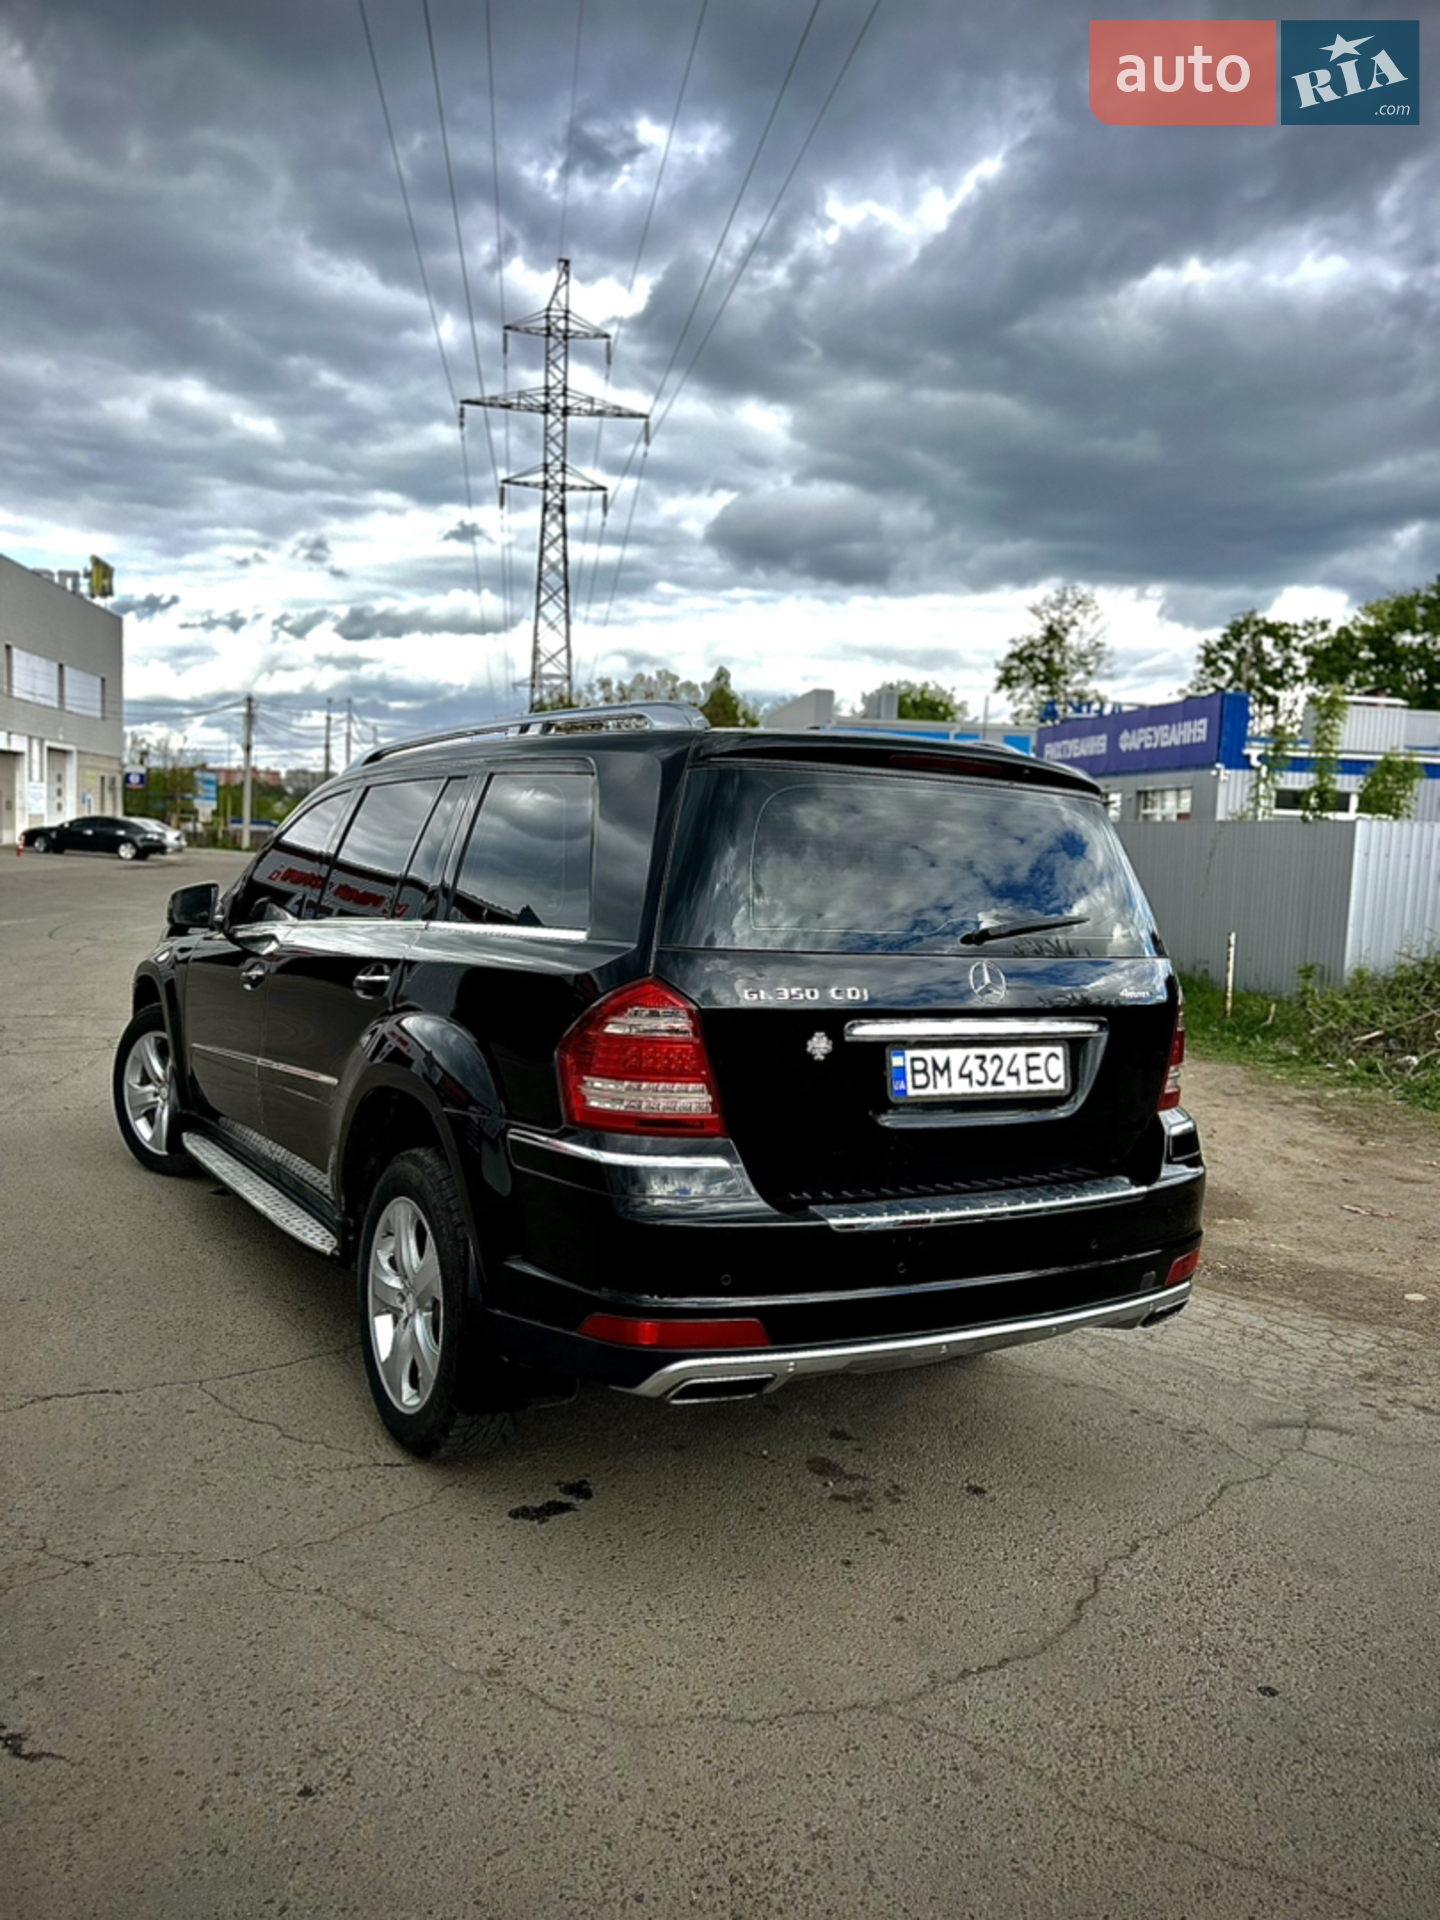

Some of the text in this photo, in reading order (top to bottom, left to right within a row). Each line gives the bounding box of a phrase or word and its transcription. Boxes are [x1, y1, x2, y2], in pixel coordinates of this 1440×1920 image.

[1118, 718, 1208, 752] ФАРБУВАННЯ
[775, 986, 820, 1000] 350
[830, 986, 869, 1001] CDI
